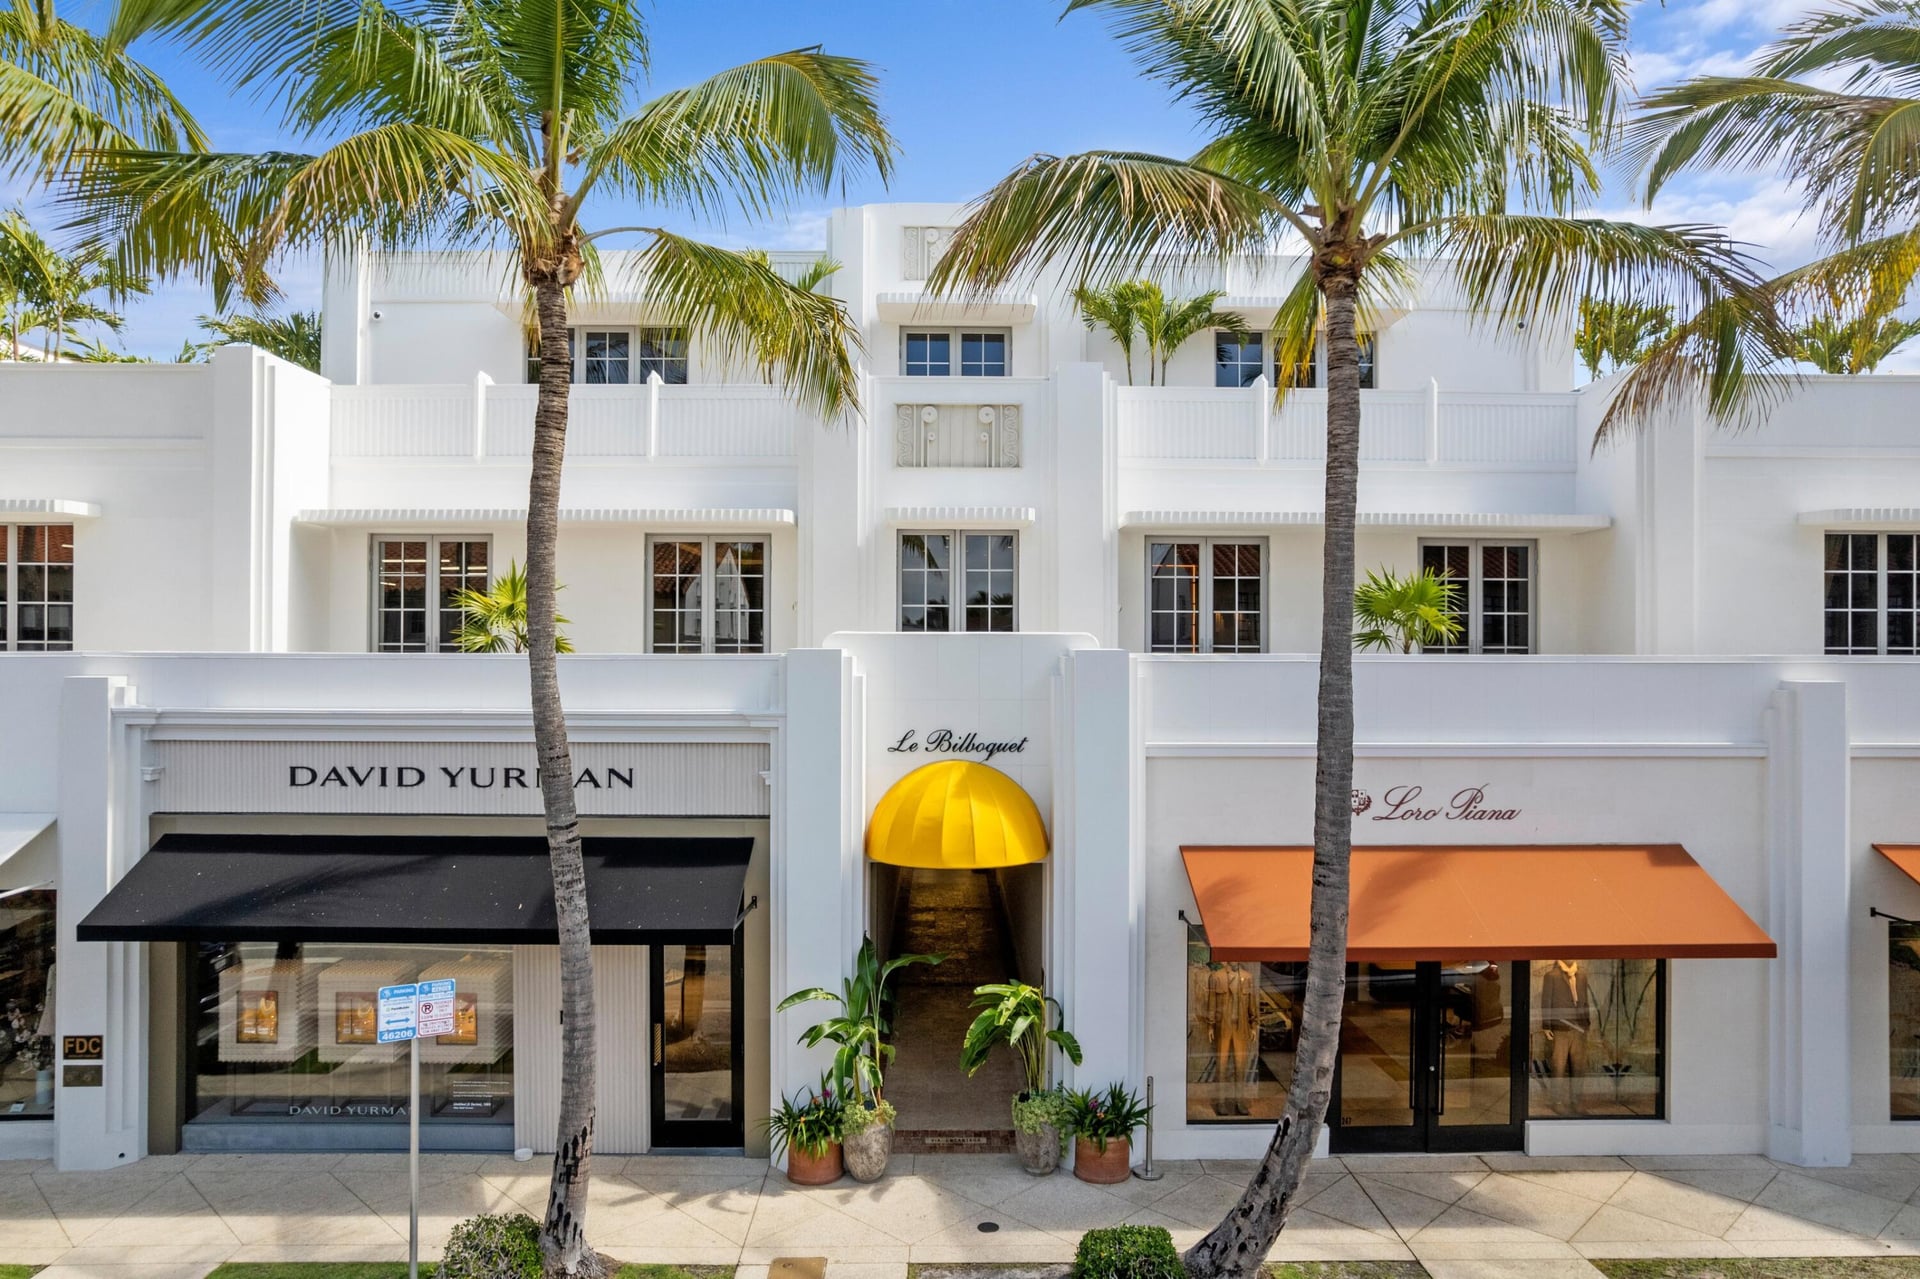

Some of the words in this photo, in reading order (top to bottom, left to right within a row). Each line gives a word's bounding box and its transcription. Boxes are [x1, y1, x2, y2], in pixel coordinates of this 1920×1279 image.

[887, 729, 919, 753] Le
[925, 728, 1029, 763] Bilboquet
[289, 765, 426, 788] DAVID
[439, 766, 634, 789] YURAN
[1372, 785, 1443, 821] Loro
[1445, 782, 1522, 821] Piana
[64, 1037, 101, 1054] FDC
[382, 1030, 413, 1041] 46206
[289, 1105, 342, 1115] DAVID
[346, 1105, 411, 1115] YURMA
